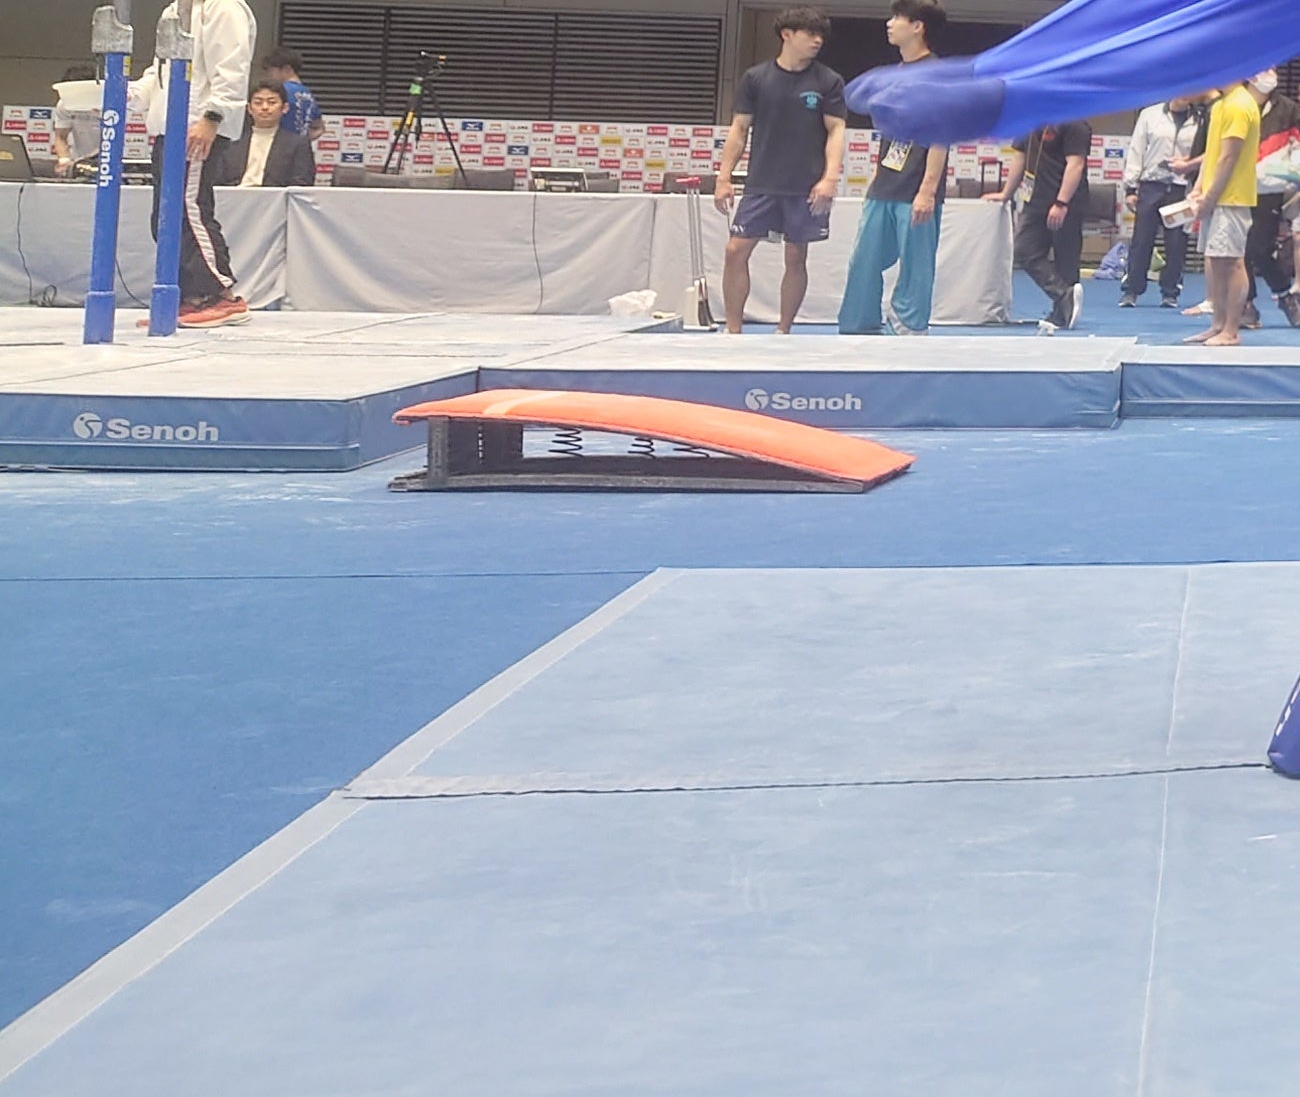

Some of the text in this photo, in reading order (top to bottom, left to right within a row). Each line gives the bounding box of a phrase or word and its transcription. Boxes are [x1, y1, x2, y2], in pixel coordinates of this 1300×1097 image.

[100, 127, 115, 187] Senoh
[770, 392, 862, 411] Senoh
[106, 417, 219, 442] Senoh
